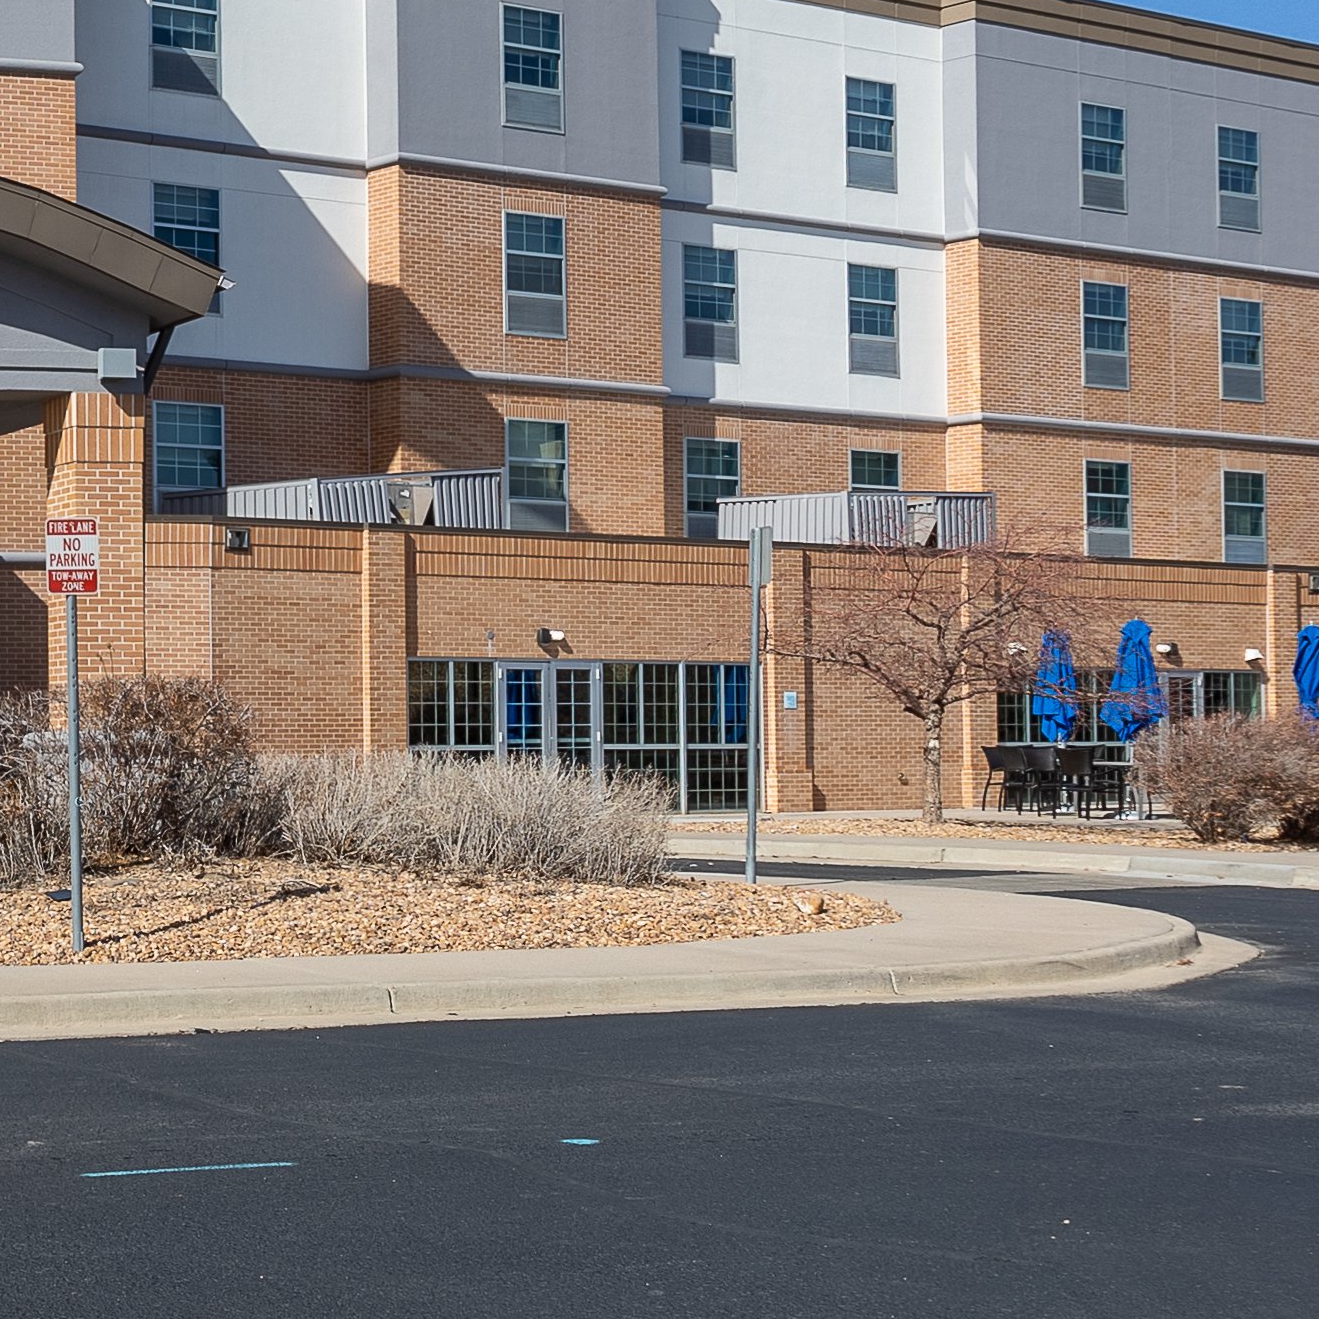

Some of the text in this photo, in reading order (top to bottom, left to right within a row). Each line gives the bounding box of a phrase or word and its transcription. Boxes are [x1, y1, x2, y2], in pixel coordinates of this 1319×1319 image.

[48, 521, 95, 534] FIRE LANE
[63, 537, 81, 552] NO
[49, 552, 95, 567] PARKING
[51, 571, 94, 581] TOW-AWAY
[61, 581, 85, 592] ZONE
